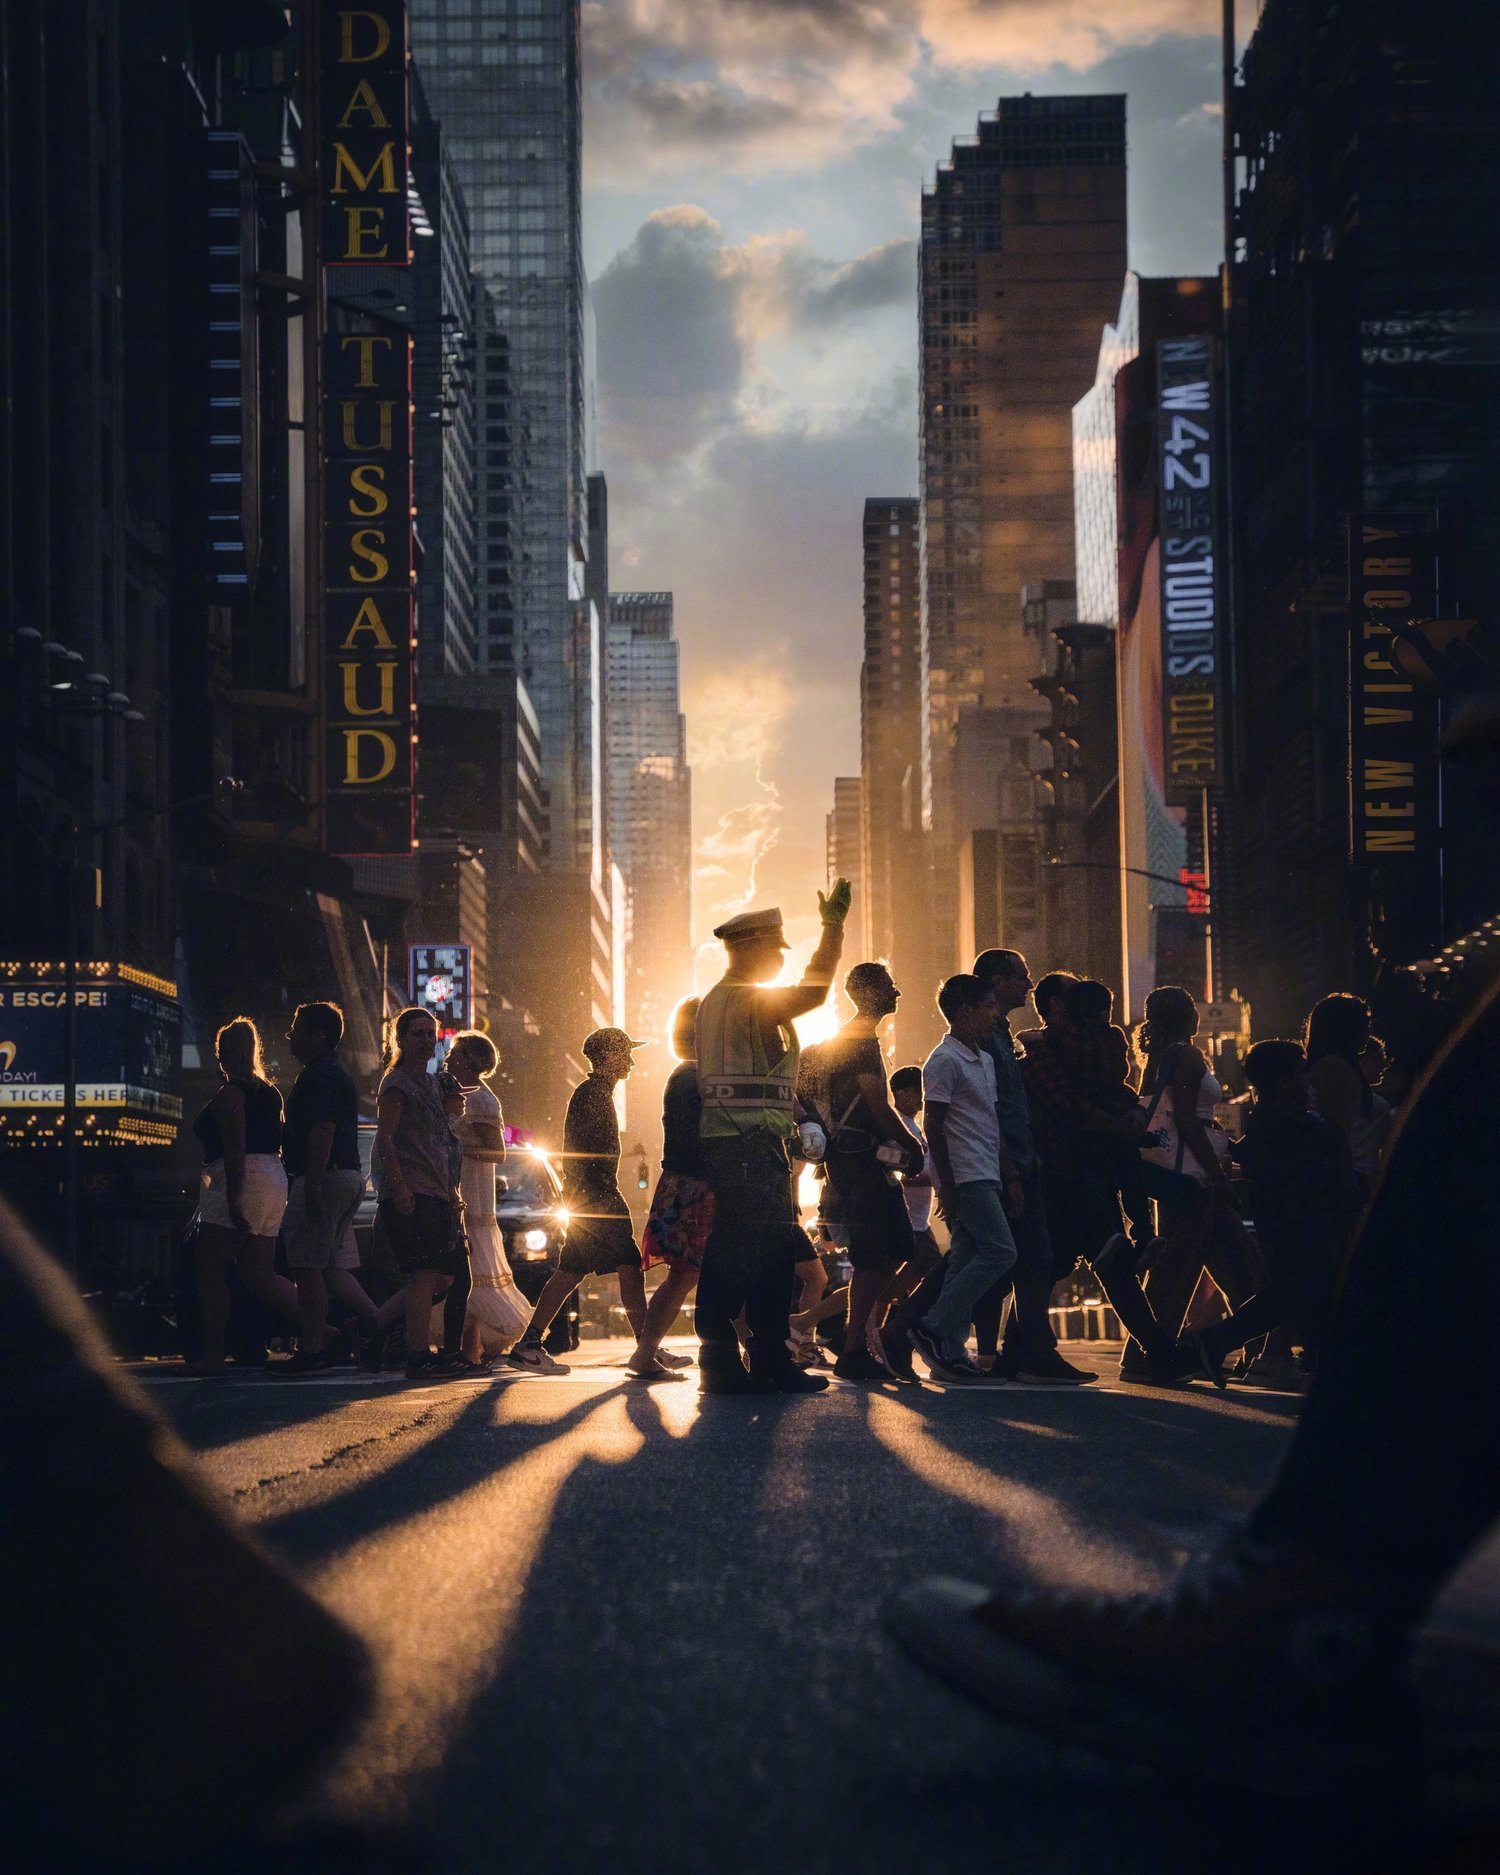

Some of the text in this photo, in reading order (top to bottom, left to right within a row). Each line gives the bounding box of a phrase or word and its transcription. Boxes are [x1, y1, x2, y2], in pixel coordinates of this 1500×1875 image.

[329, 10, 400, 259] DAME
[340, 336, 398, 784] TUSSAUD
[1164, 534, 1216, 678] STUDIOS
[1170, 693, 1216, 774] DUKE
[1363, 758, 1416, 852] NEW
[13, 991, 107, 1008] ESCAPE!
[0, 1071, 37, 1083] DAY!
[9, 1090, 87, 1102] TICKES
